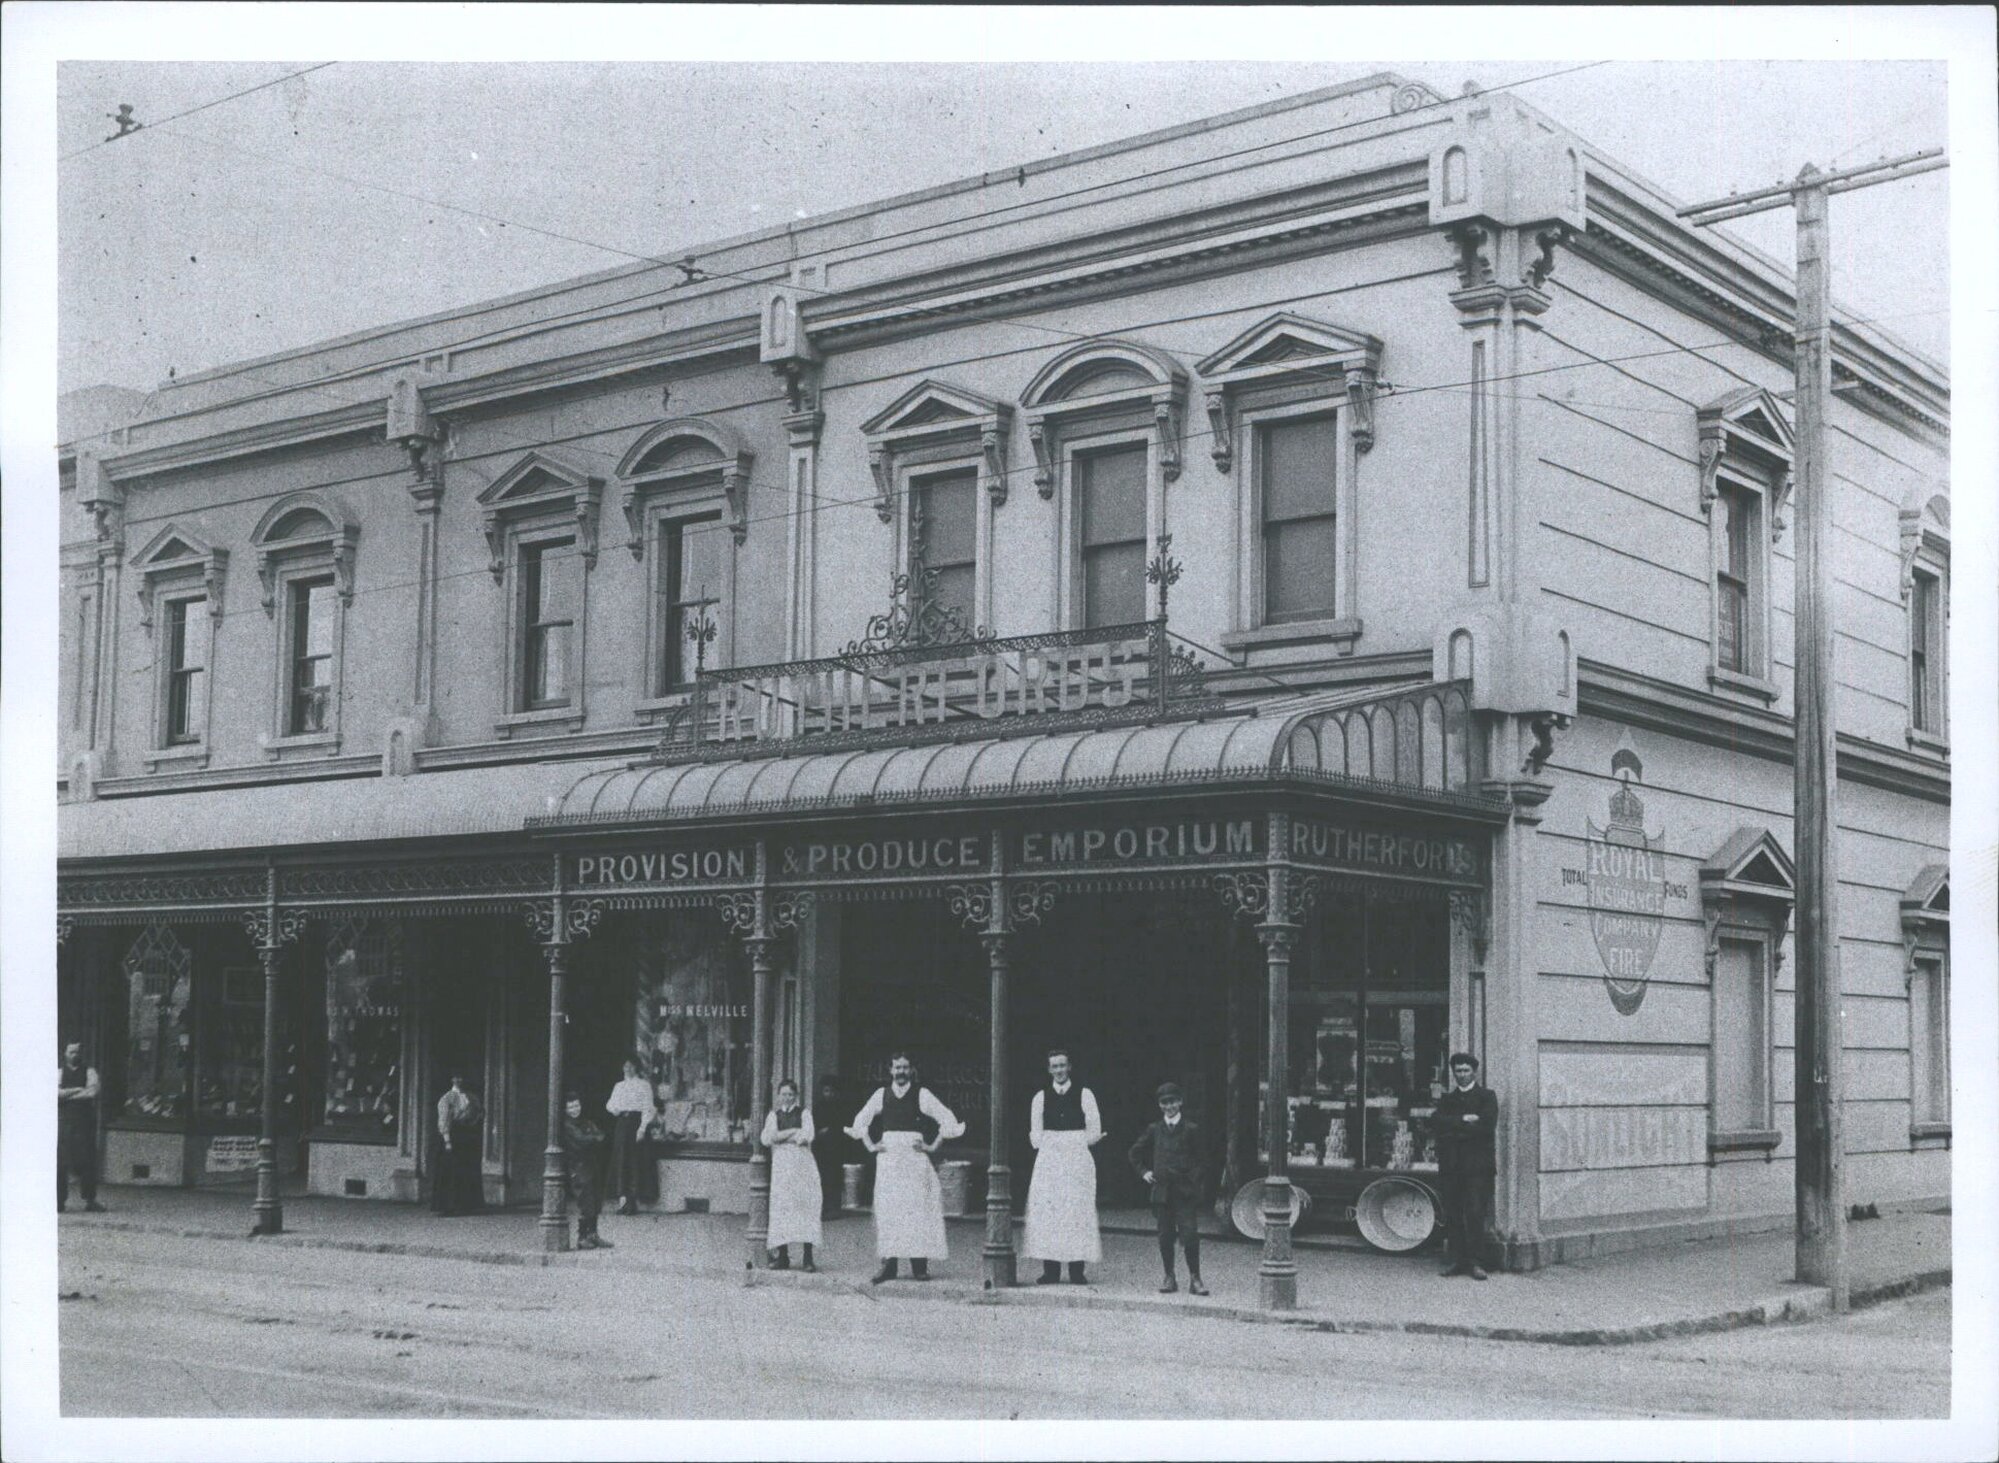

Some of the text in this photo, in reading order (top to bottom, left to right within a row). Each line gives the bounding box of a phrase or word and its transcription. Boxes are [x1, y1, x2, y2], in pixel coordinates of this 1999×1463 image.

[578, 820, 1253, 885] PROVISION & PRODUCE EMPORIUM
[1589, 836, 1662, 883] ROYAL
[1562, 867, 1688, 899] TOTAL FUNDS
[1590, 879, 1664, 914] INSURANCE
[1594, 911, 1659, 942] COMPANY
[1609, 947, 1645, 975] FIRE
[686, 1004, 748, 1018] MELVILLE
